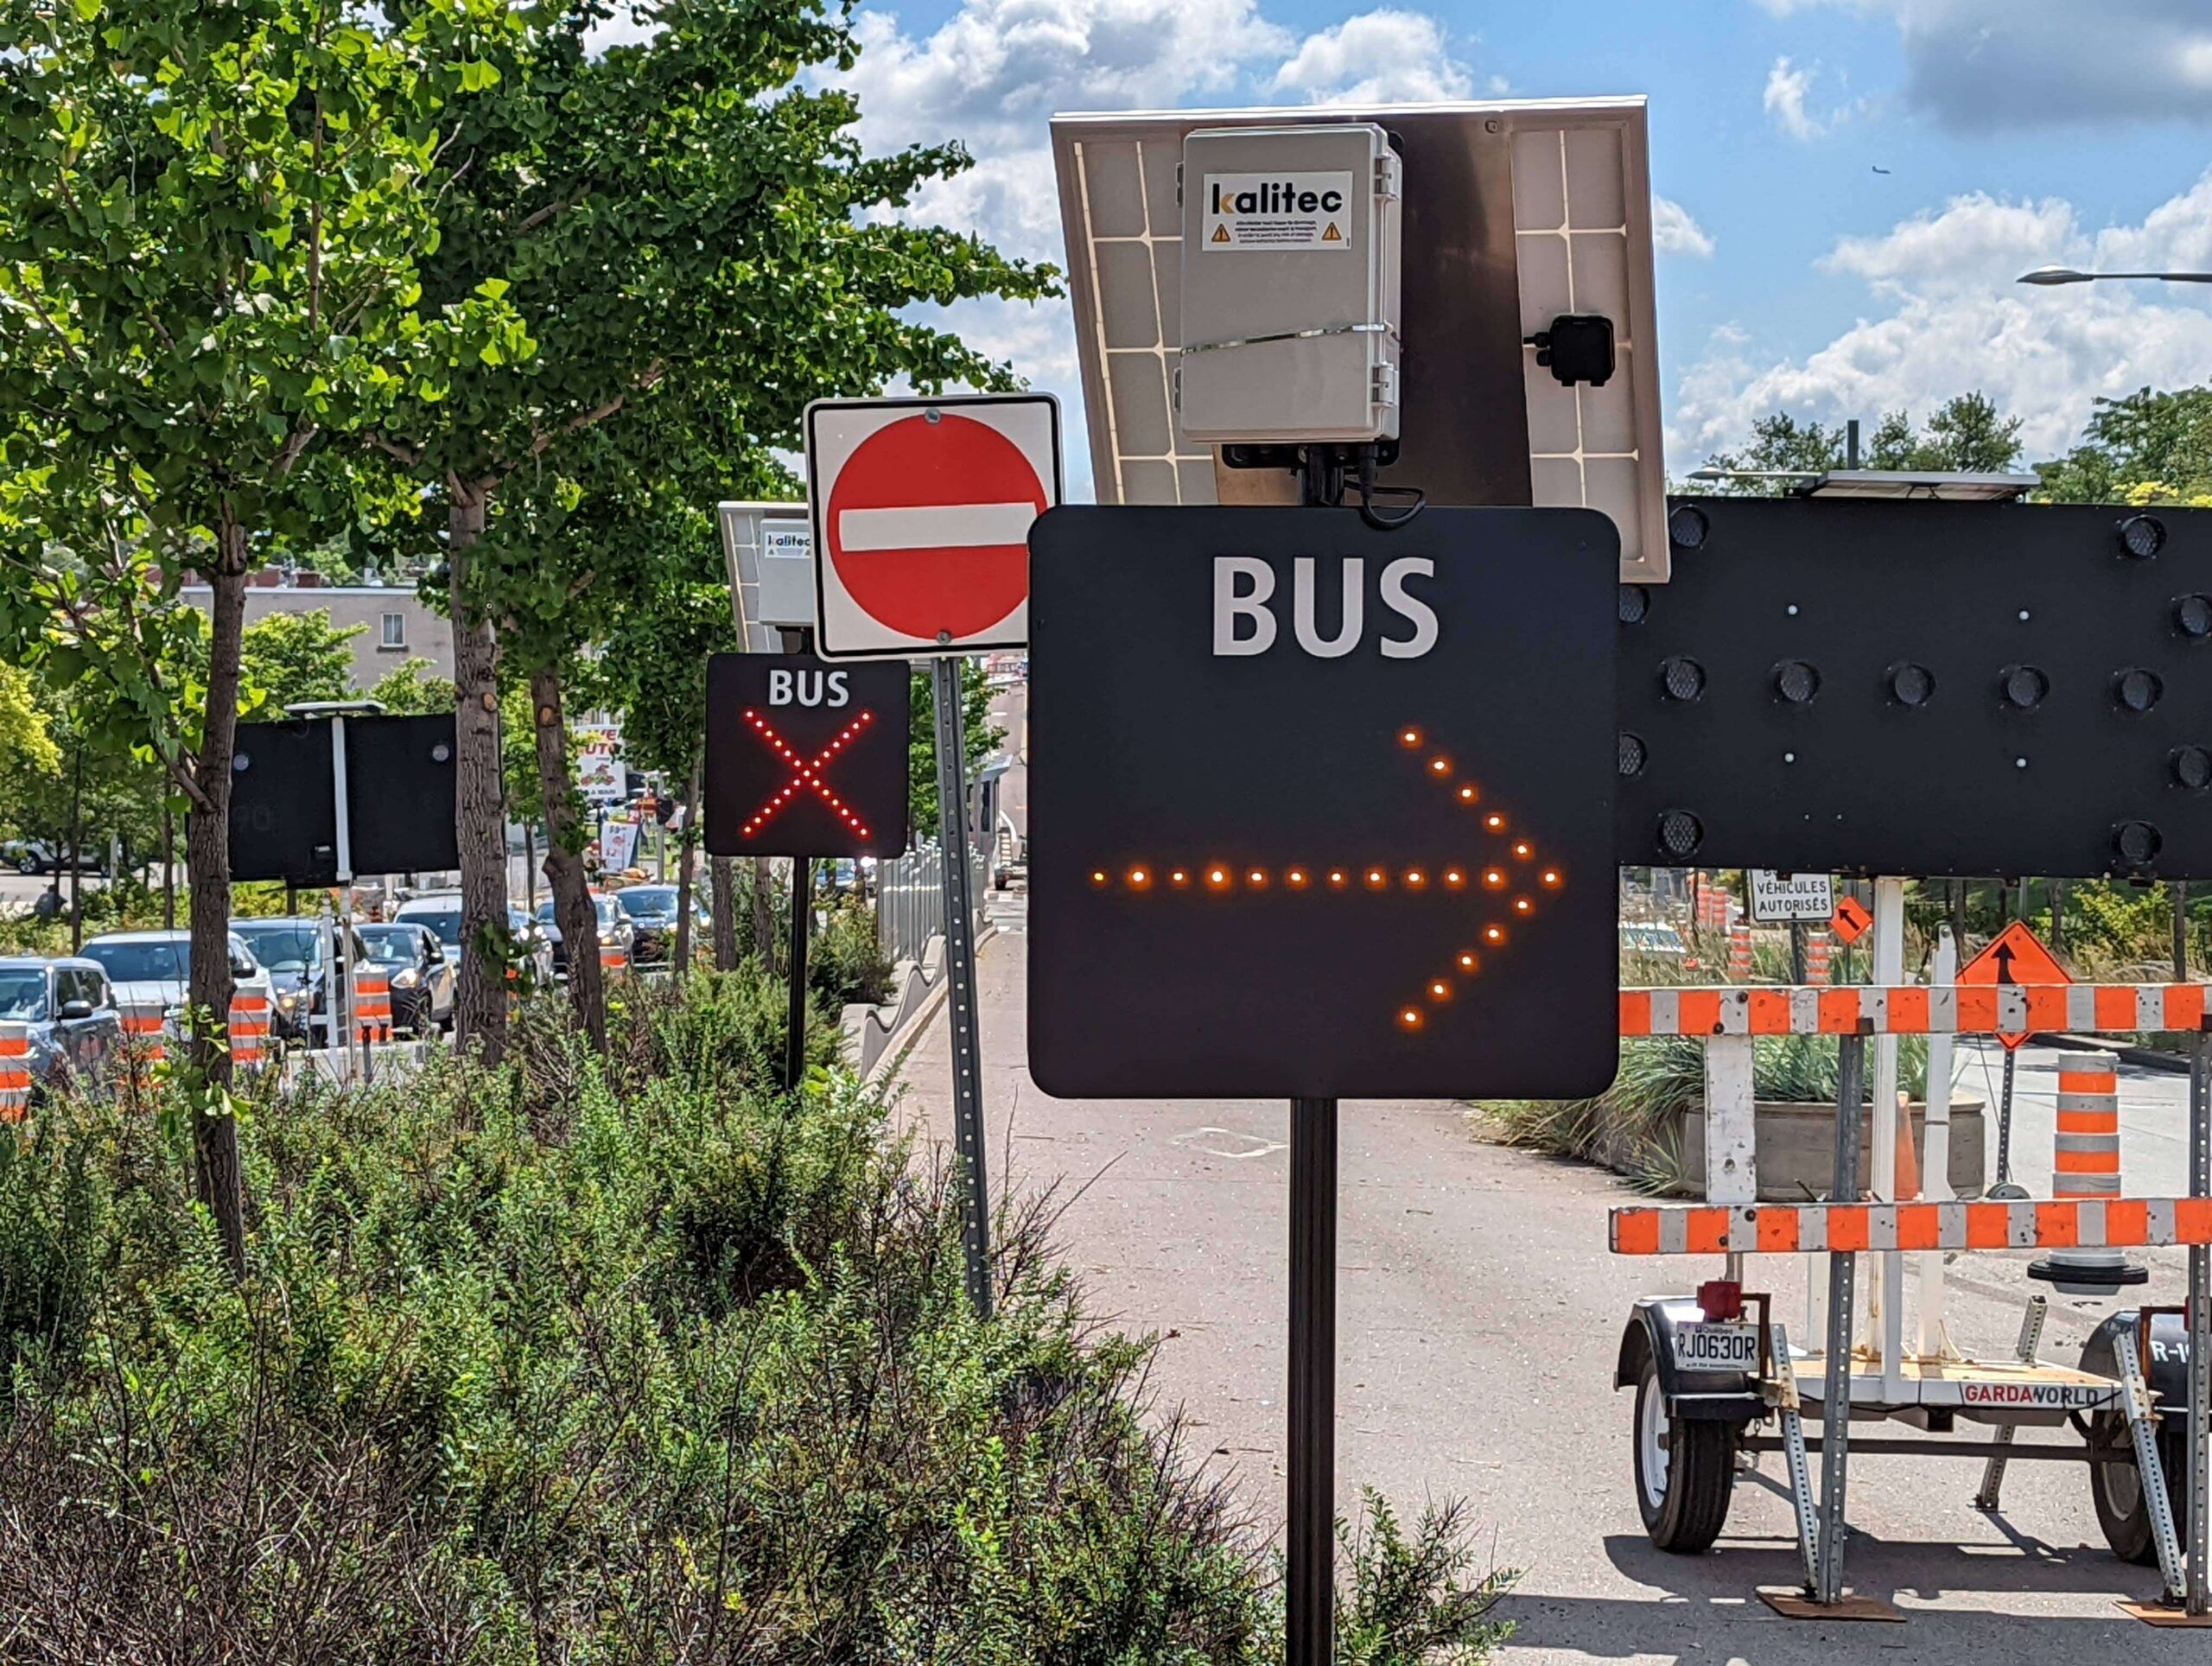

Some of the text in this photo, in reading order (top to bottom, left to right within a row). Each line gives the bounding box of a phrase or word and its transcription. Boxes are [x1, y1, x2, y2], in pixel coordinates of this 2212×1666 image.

[1212, 182, 1342, 214] kalitec
[1212, 556, 1439, 658] BUS
[769, 670, 849, 707] BUS
[1758, 880, 1827, 894] VÉHICULES
[1759, 897, 1828, 912] AUTORISÉS
[1678, 1333, 1756, 1361] RJ0630R
